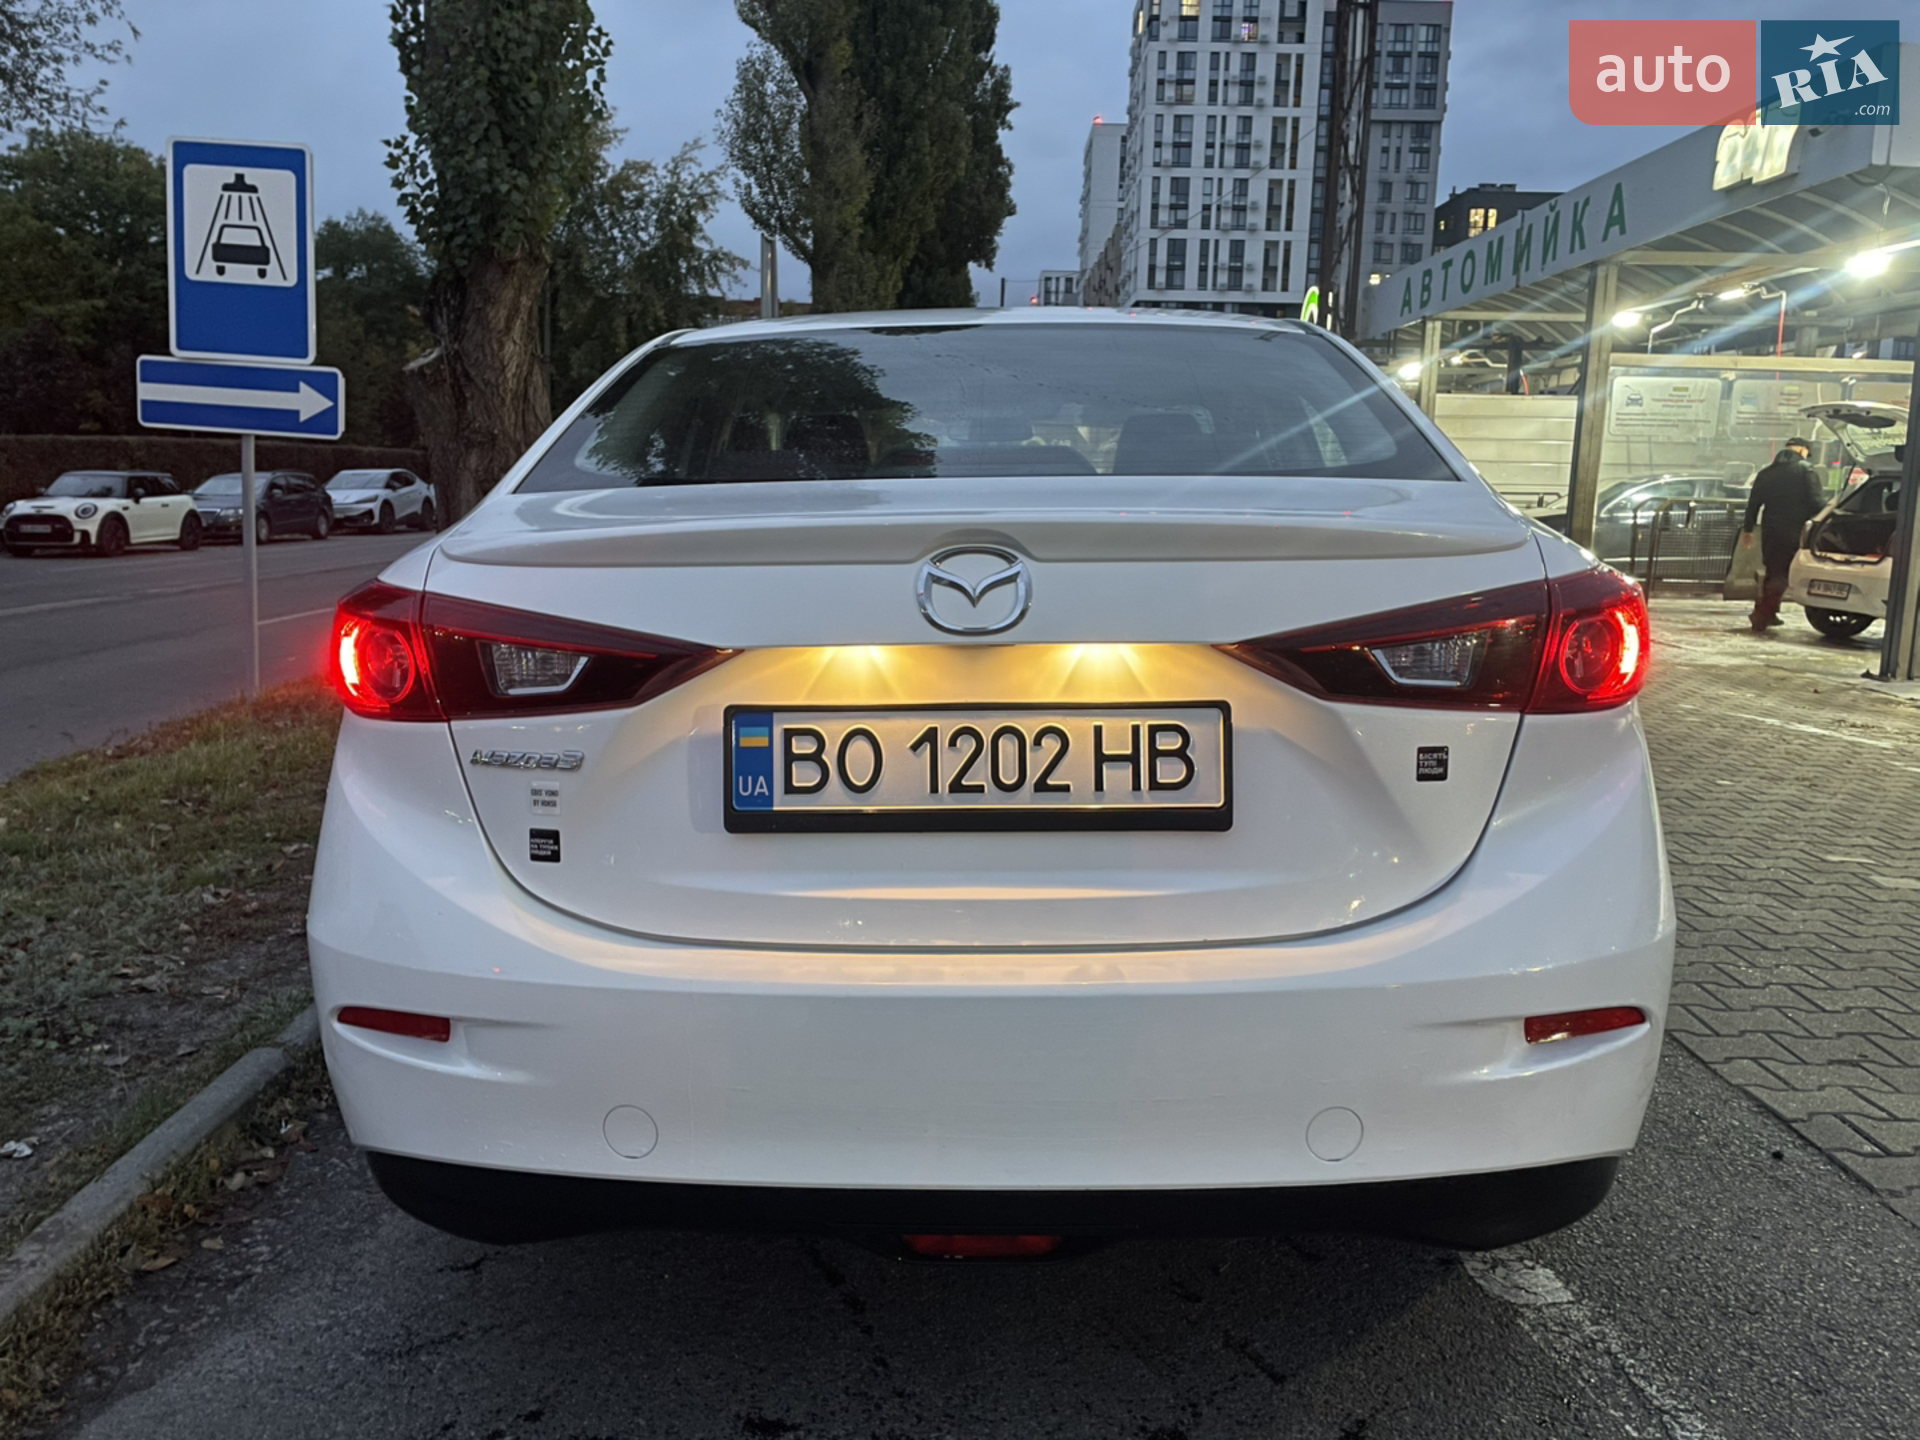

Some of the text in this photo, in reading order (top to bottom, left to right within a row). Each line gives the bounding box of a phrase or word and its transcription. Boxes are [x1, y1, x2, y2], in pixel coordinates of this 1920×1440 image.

[1399, 181, 1627, 318] АВТОМИЙКА
[738, 775, 770, 797] UA
[783, 721, 1197, 795] BO 1202 HB
